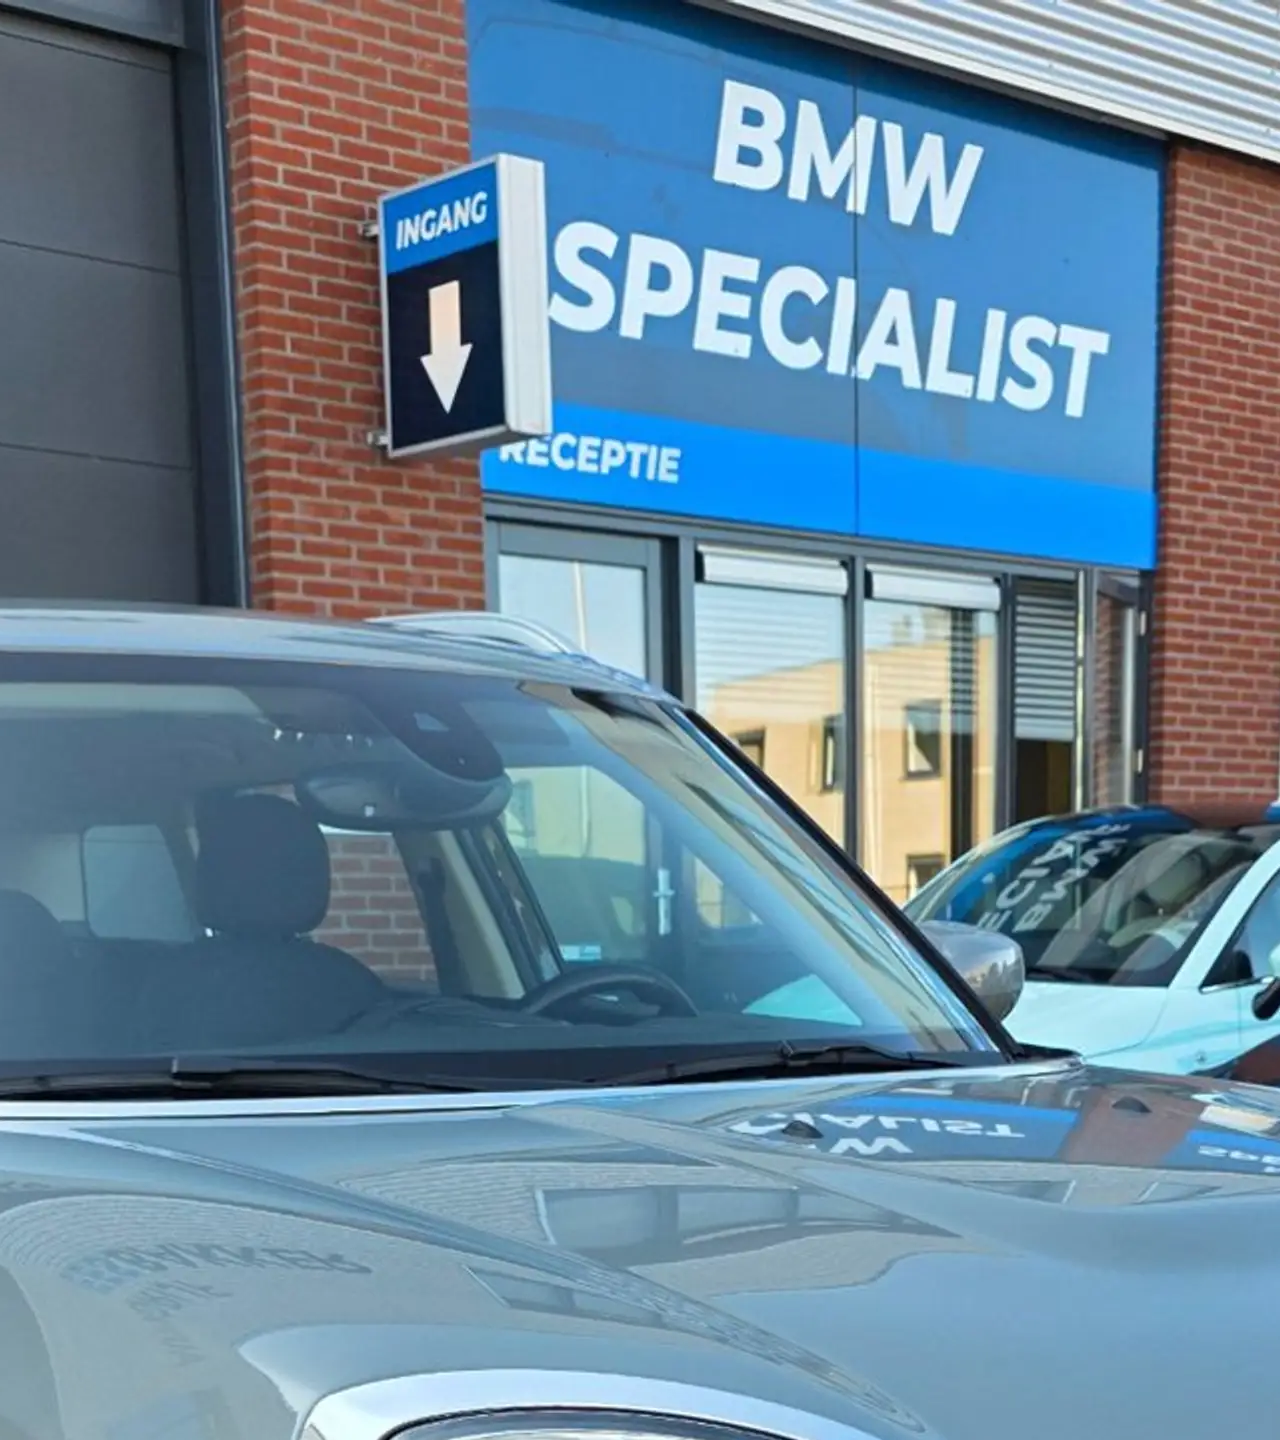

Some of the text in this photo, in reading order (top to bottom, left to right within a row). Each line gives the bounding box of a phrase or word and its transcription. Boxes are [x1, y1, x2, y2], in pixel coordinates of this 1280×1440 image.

[396, 191, 488, 250] INGANG
[714, 79, 984, 236] BMW
[549, 220, 1111, 418] SPECIALIST
